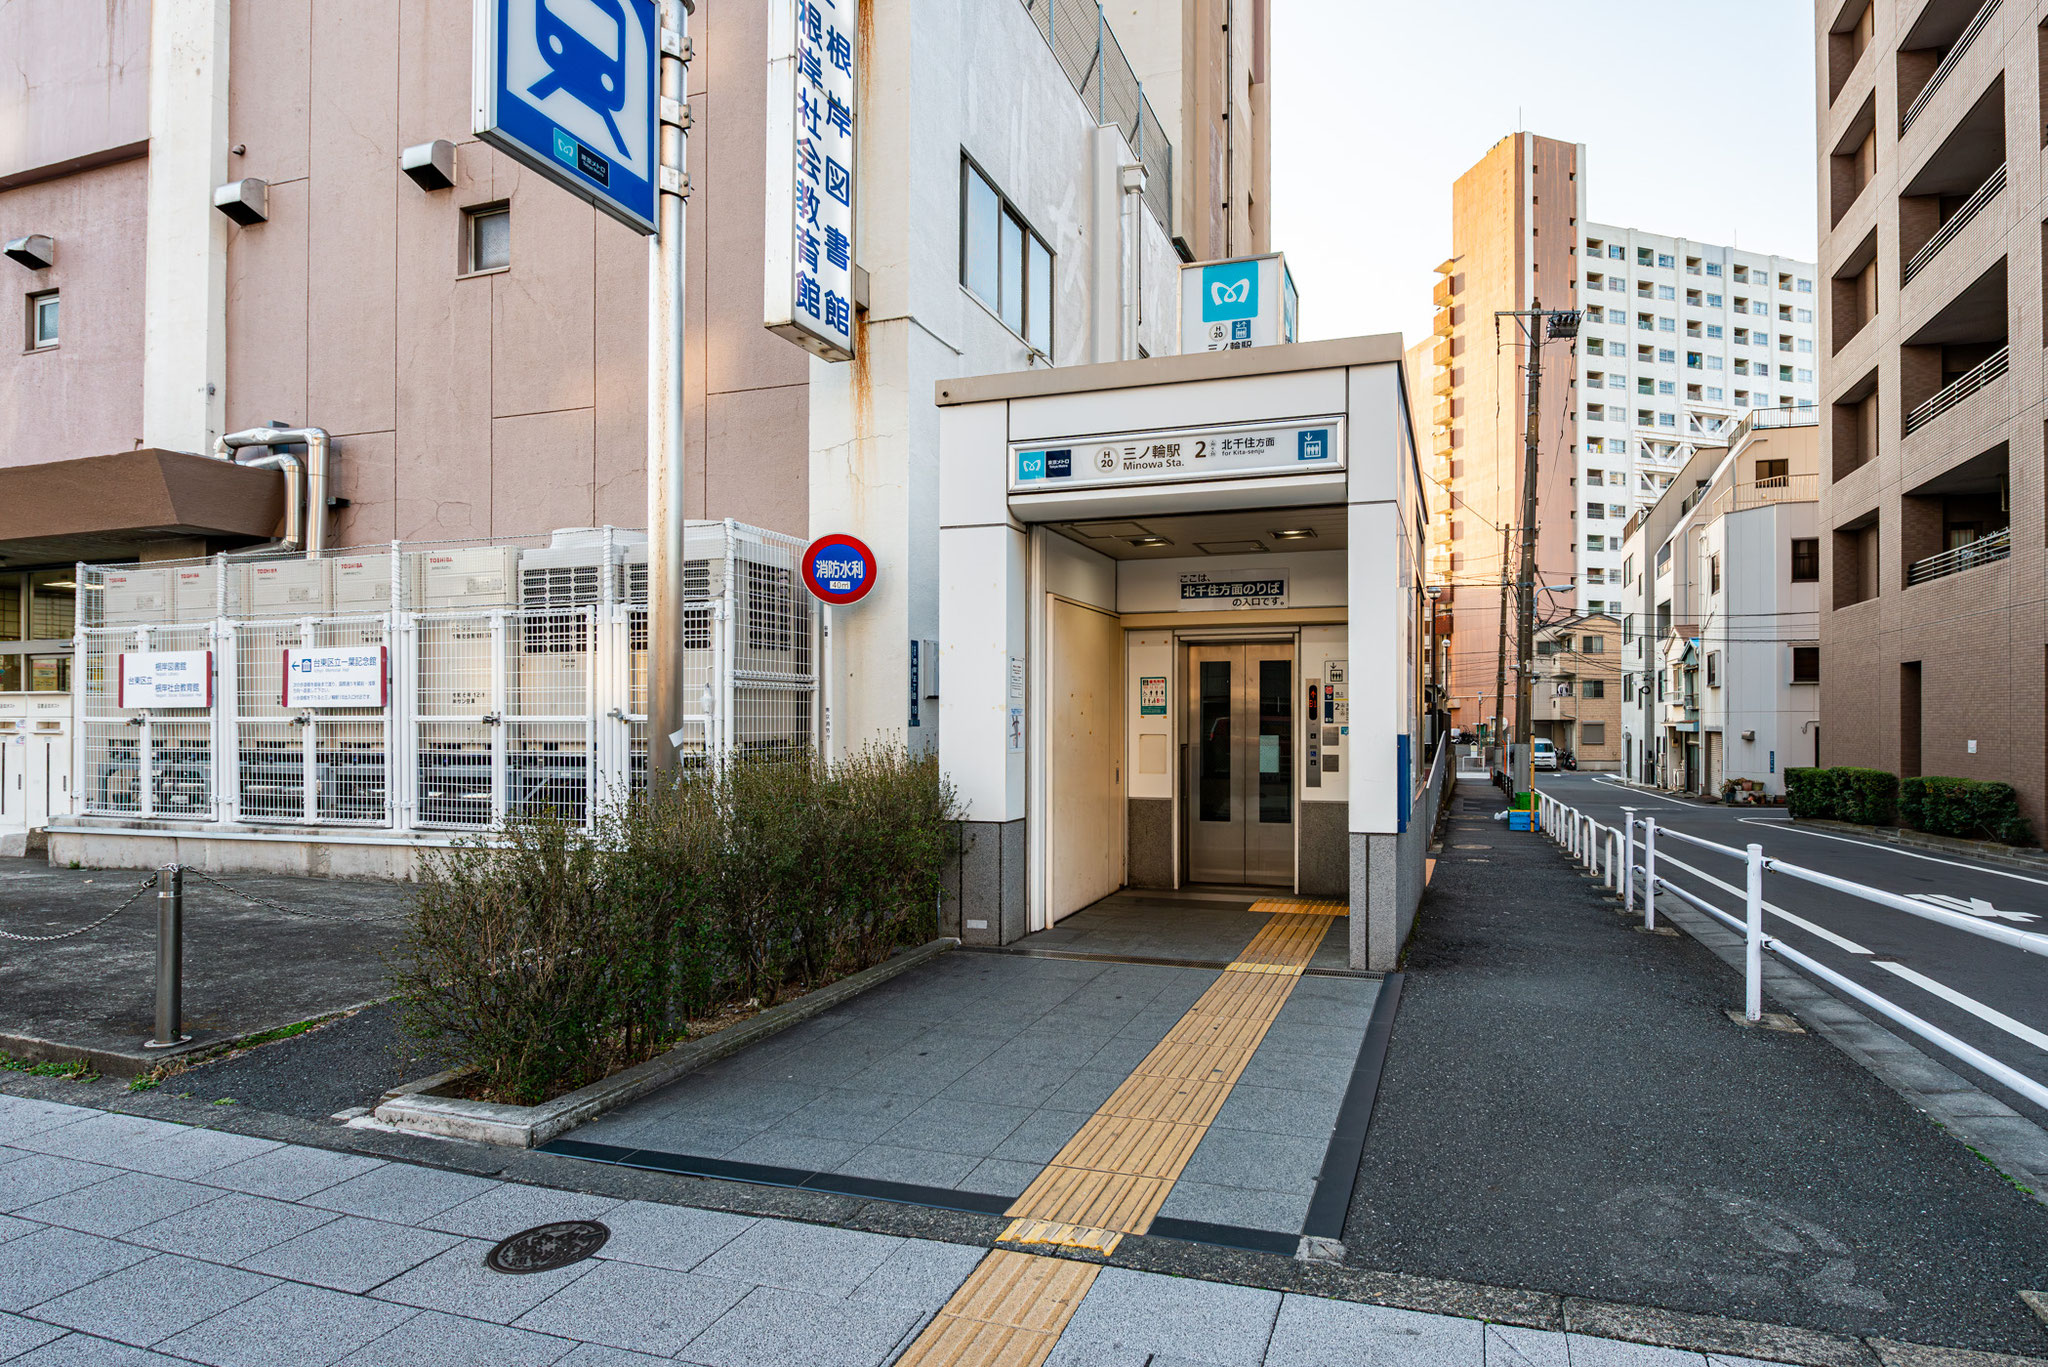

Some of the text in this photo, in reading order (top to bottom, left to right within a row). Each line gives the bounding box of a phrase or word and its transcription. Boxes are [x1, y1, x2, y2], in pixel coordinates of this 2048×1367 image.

[581, 154, 606, 174] 東京メトロ
[796, 0, 823, 321] 根岸社会教育館
[824, 0, 853, 337] 根岸図書館
[1195, 440, 1206, 458] 2
[1222, 437, 1275, 450] 北千住方面
[1123, 444, 1181, 461] 三ノ輪駅
[1233, 448, 1264, 456] Kita-senju
[1048, 458, 1070, 466] 東京メトロ
[1101, 459, 1114, 468] 20
[1123, 460, 1184, 471] Minowa Sta.
[816, 560, 864, 579] 消防水利
[1184, 582, 1280, 598] 北千住方面のりば
[1232, 597, 1284, 606] の入口です。
[156, 662, 186, 672] 根岸図書館
[314, 657, 376, 668] 台東区立一葉記念館
[128, 676, 152, 686] 台東区立
[155, 683, 200, 692] 根岸社会教育館
[1335, 702, 1340, 710] 2
